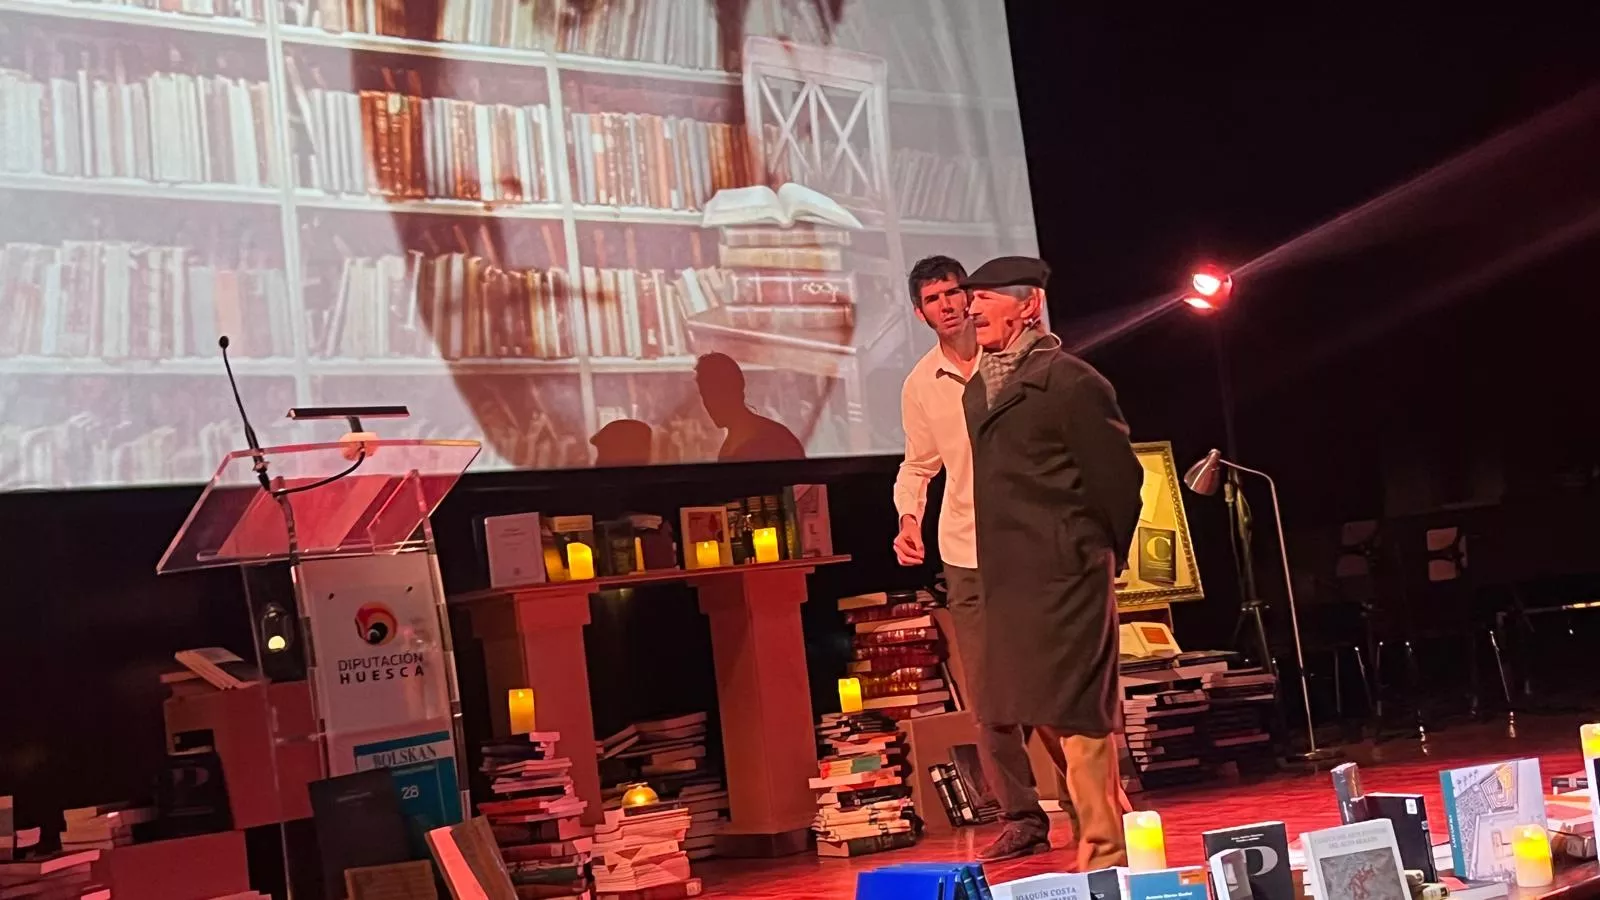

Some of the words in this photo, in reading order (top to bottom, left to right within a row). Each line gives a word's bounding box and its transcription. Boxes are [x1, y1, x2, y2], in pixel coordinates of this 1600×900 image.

[1146, 536, 1171, 561] C
[338, 650, 424, 671] DIPUTACIÓN
[340, 665, 424, 684] HUESCA
[373, 745, 437, 768] BOLSKAN
[402, 784, 419, 800] 28
[1050, 886, 1077, 896] COSTA
